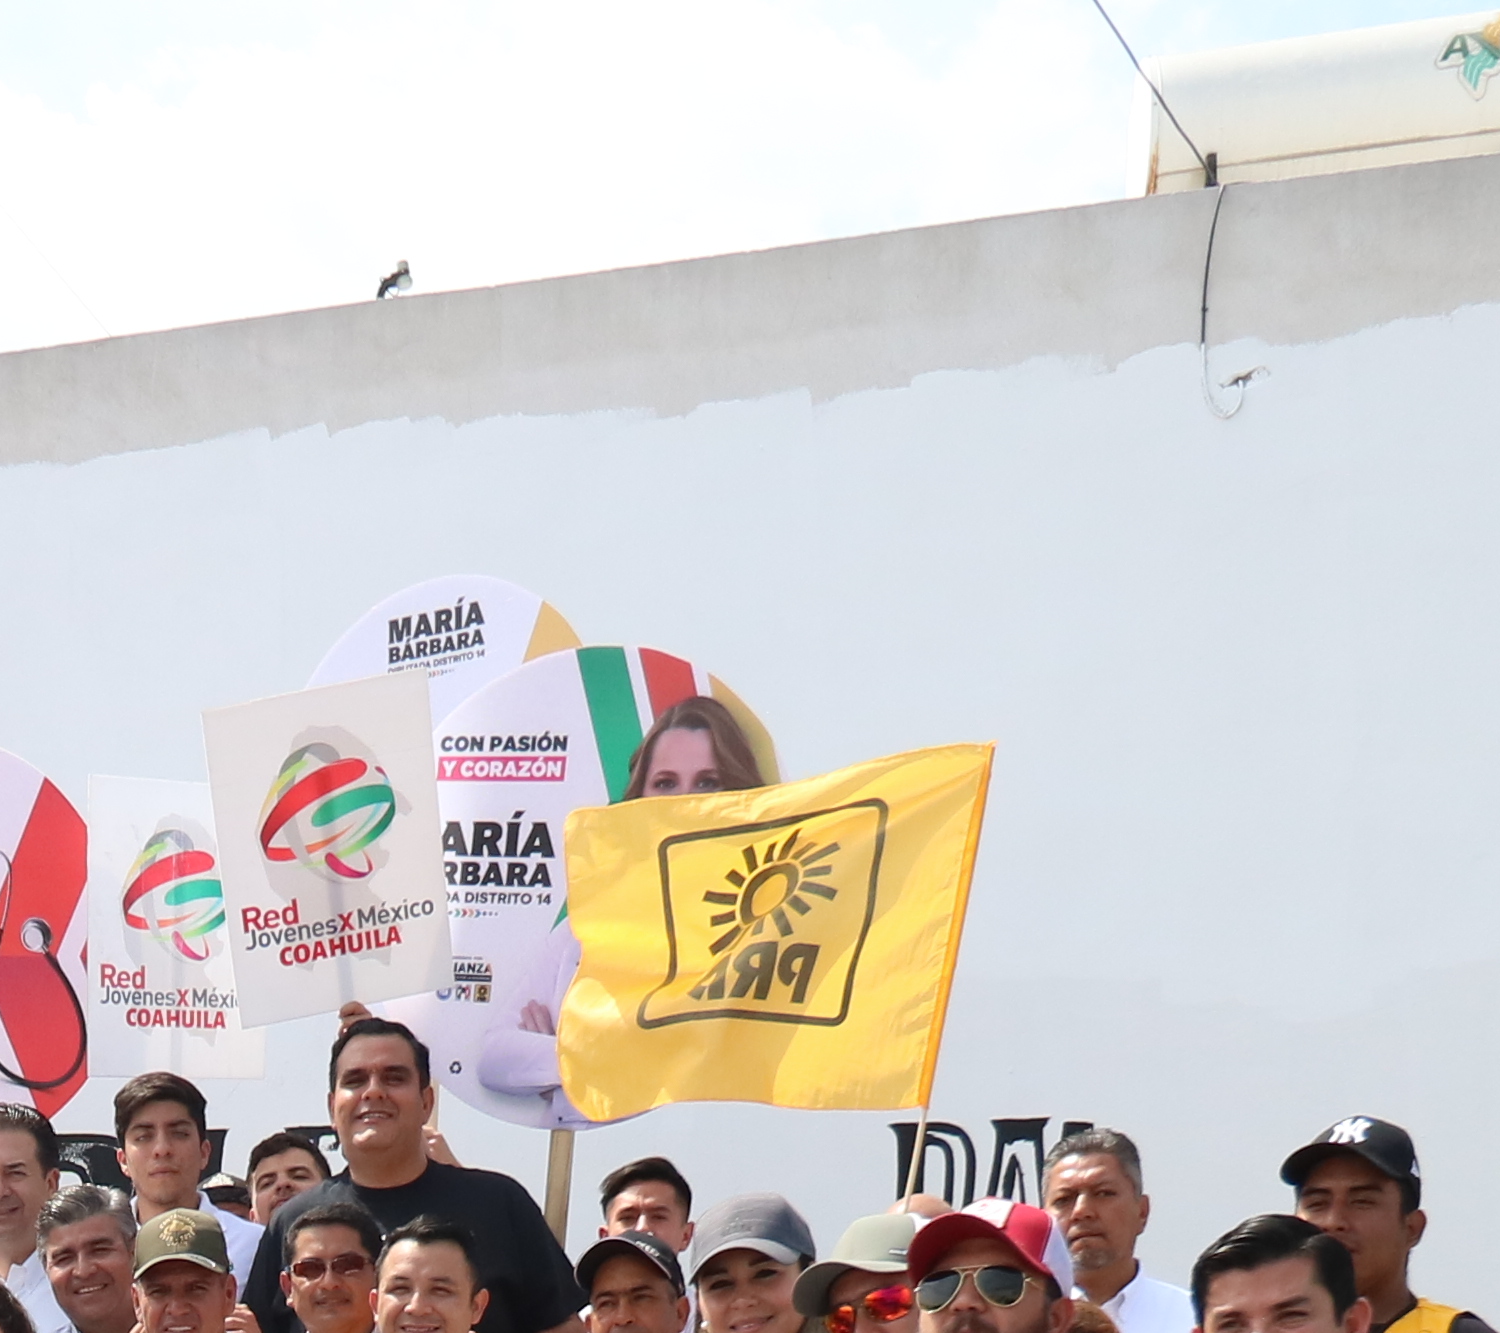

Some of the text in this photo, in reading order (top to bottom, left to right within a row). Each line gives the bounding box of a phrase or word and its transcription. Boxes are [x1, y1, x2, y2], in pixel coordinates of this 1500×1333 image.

[388, 596, 485, 645] MARÍA
[388, 629, 485, 665] BÁRBARA
[433, 651, 475, 667] DISTRITO
[440, 731, 569, 753] CON PASIÓN
[442, 757, 562, 778] Y CORAZÓN
[441, 810, 556, 858] ARÍA
[444, 861, 552, 888] RBARA
[464, 891, 532, 905] DISTRITO
[536, 893, 552, 905] 14
[241, 898, 300, 934] Red
[279, 925, 402, 967] COAHUILA
[100, 963, 146, 989] Red
[453, 961, 492, 974] IANZA
[126, 1008, 226, 1029] COAHUILA
